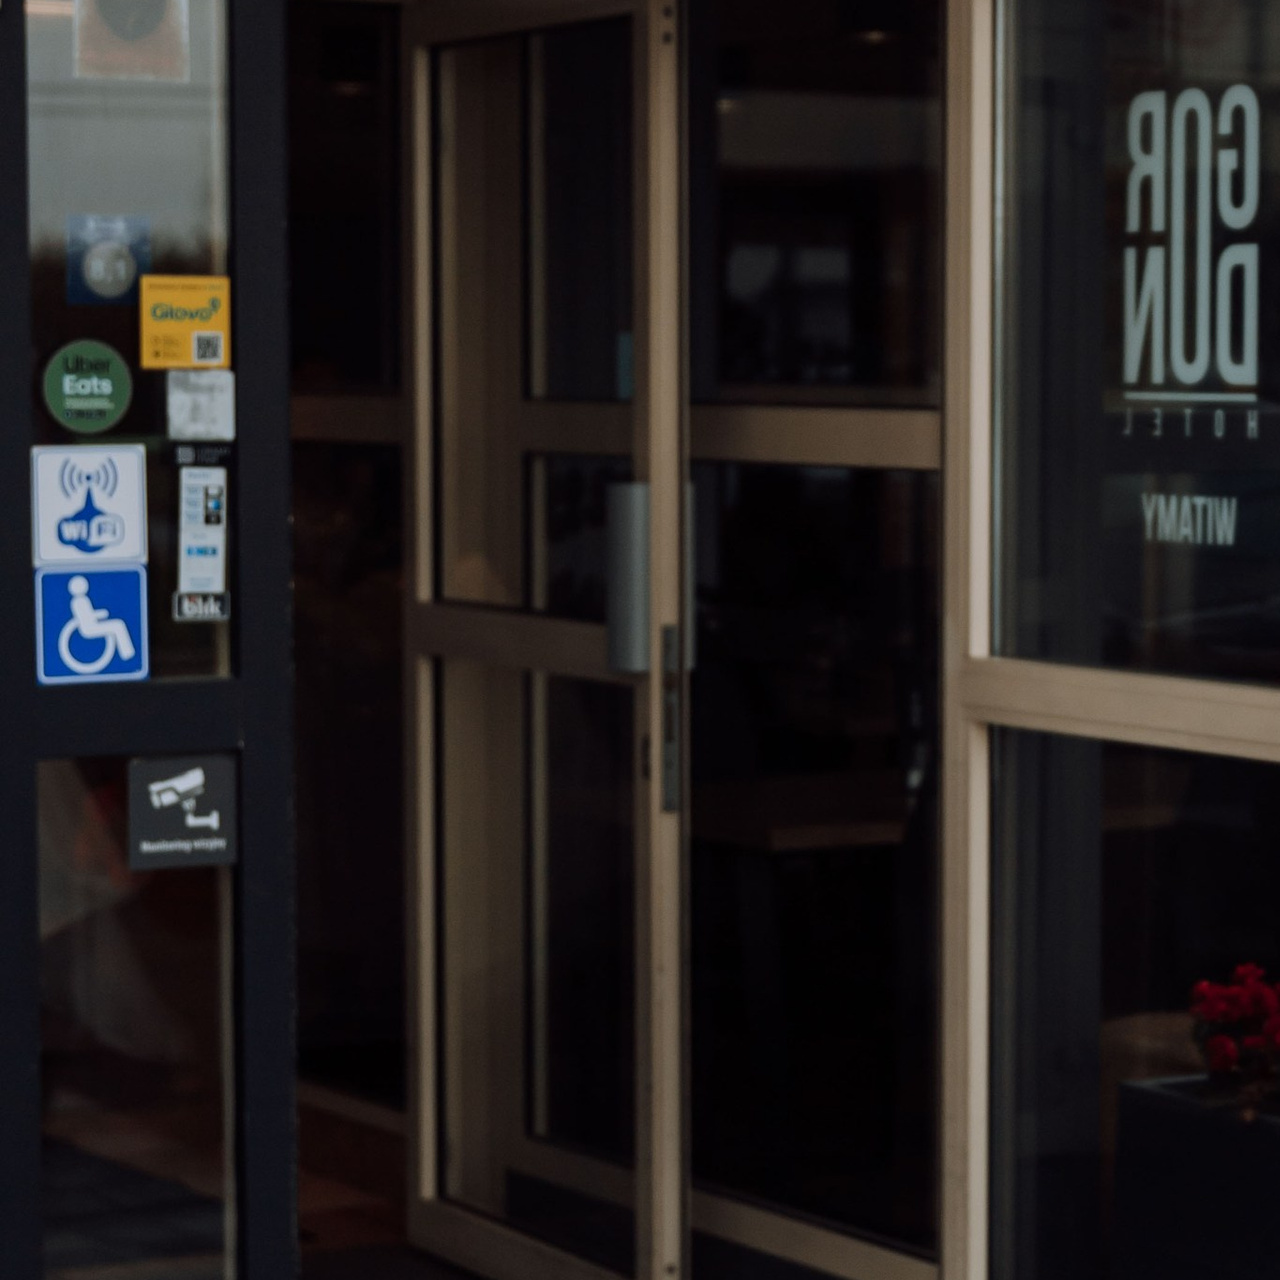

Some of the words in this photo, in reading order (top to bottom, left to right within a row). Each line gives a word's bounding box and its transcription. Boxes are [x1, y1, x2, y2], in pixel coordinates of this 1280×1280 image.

[150, 300, 218, 323] Glovo
[63, 355, 111, 374] Uber
[62, 373, 114, 396] Eats
[181, 594, 222, 618] blik
